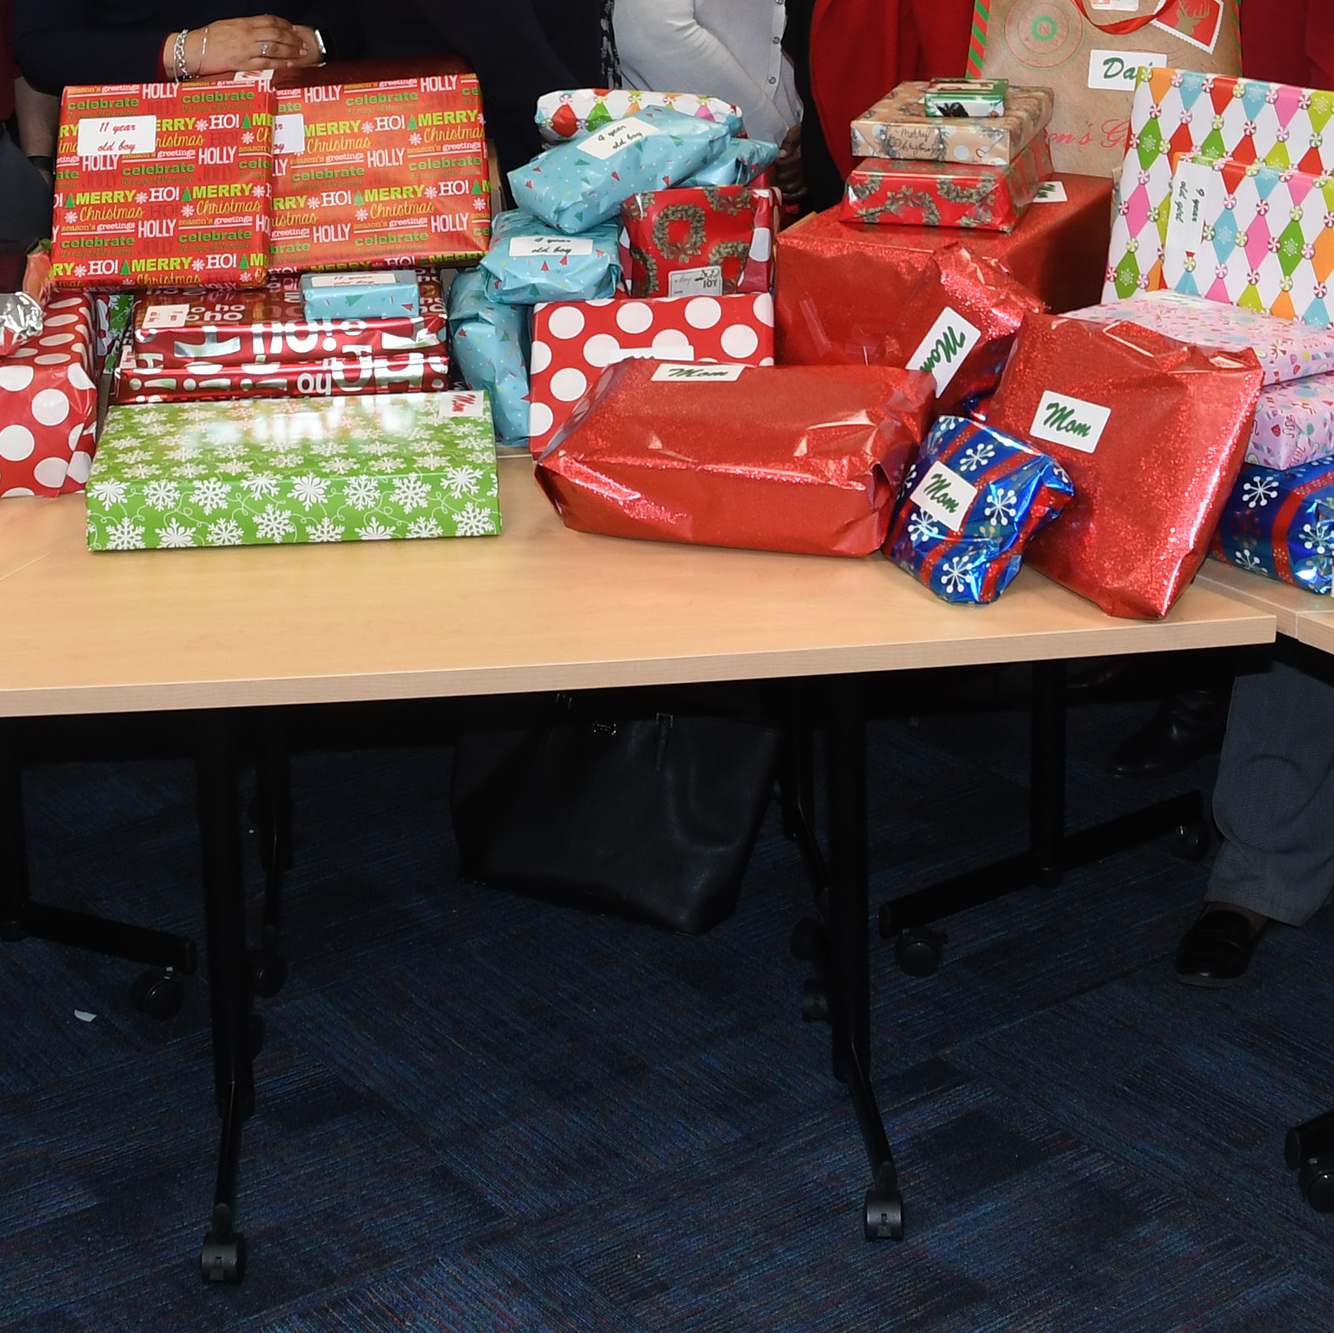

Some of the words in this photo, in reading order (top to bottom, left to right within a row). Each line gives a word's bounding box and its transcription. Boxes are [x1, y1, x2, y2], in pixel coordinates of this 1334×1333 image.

[102, 84, 140, 94] greetings
[142, 81, 180, 99] HOLLY
[304, 84, 342, 103] HOLLY
[379, 78, 417, 88] greetings
[420, 74, 458, 93] HOLLY
[345, 91, 418, 106] celebrate
[68, 97, 139, 111] celebrate
[182, 90, 255, 104] celebrate
[99, 122, 109, 132] 11
[113, 124, 136, 134] year
[156, 117, 196, 132] ERRY
[208, 113, 240, 129] HO!
[305, 119, 361, 136] MERRY
[375, 115, 405, 131] HO!
[418, 109, 478, 126] MERRY
[608, 125, 627, 137] year
[97, 141, 115, 152] old
[117, 140, 136, 153] boy
[156, 133, 204, 148] ristmas
[307, 136, 371, 154] Christmas
[424, 125, 485, 144] Christmas
[612, 138, 627, 150] old
[82, 155, 119, 171] HOLLY
[157, 149, 196, 159] greetings
[198, 146, 236, 165] HOLLY
[325, 152, 364, 163] greetings
[367, 148, 405, 168] HOLLY
[442, 141, 481, 153] greetings
[122, 163, 195, 176] celebrate
[292, 167, 365, 181] celebrate
[408, 156, 482, 171] celebrate
[76, 189, 136, 205] MERRY
[148, 186, 179, 202] HO!
[192, 183, 253, 199] MERRY
[273, 195, 308, 211] RRY
[321, 190, 352, 207] HO!
[364, 184, 425, 202] MERRY
[438, 179, 470, 196] HO!
[1178, 180, 1188, 200] old
[1195, 188, 1205, 197] 9
[79, 204, 144, 222] Christmas
[196, 198, 262, 216] Christmas
[370, 200, 435, 219] Christmas
[1174, 200, 1184, 223] girl
[1191, 198, 1200, 223] year
[61, 224, 96, 233] season's
[96, 221, 135, 233] greetings
[138, 218, 176, 238] HOLLY
[178, 217, 213, 226] season's
[214, 215, 253, 226] greetings
[271, 227, 310, 239] greetings
[313, 223, 351, 243] HOLLY
[389, 217, 428, 228] greetings
[431, 213, 469, 233] HOLLY
[60, 236, 135, 250] celebrate
[178, 229, 252, 243] celebrate
[270, 242, 310, 254] brate
[354, 231, 429, 247] celebrate
[553, 245, 572, 255] boy
[88, 259, 119, 275] HO!
[131, 256, 193, 272] MERRY
[205, 253, 237, 269] HO!
[136, 273, 201, 287] Christmas
[191, 306, 206, 314] o
[920, 325, 966, 372] Mom
[668, 367, 729, 378] Mom
[1043, 402, 1092, 438] Mom
[923, 473, 960, 513] Mom
